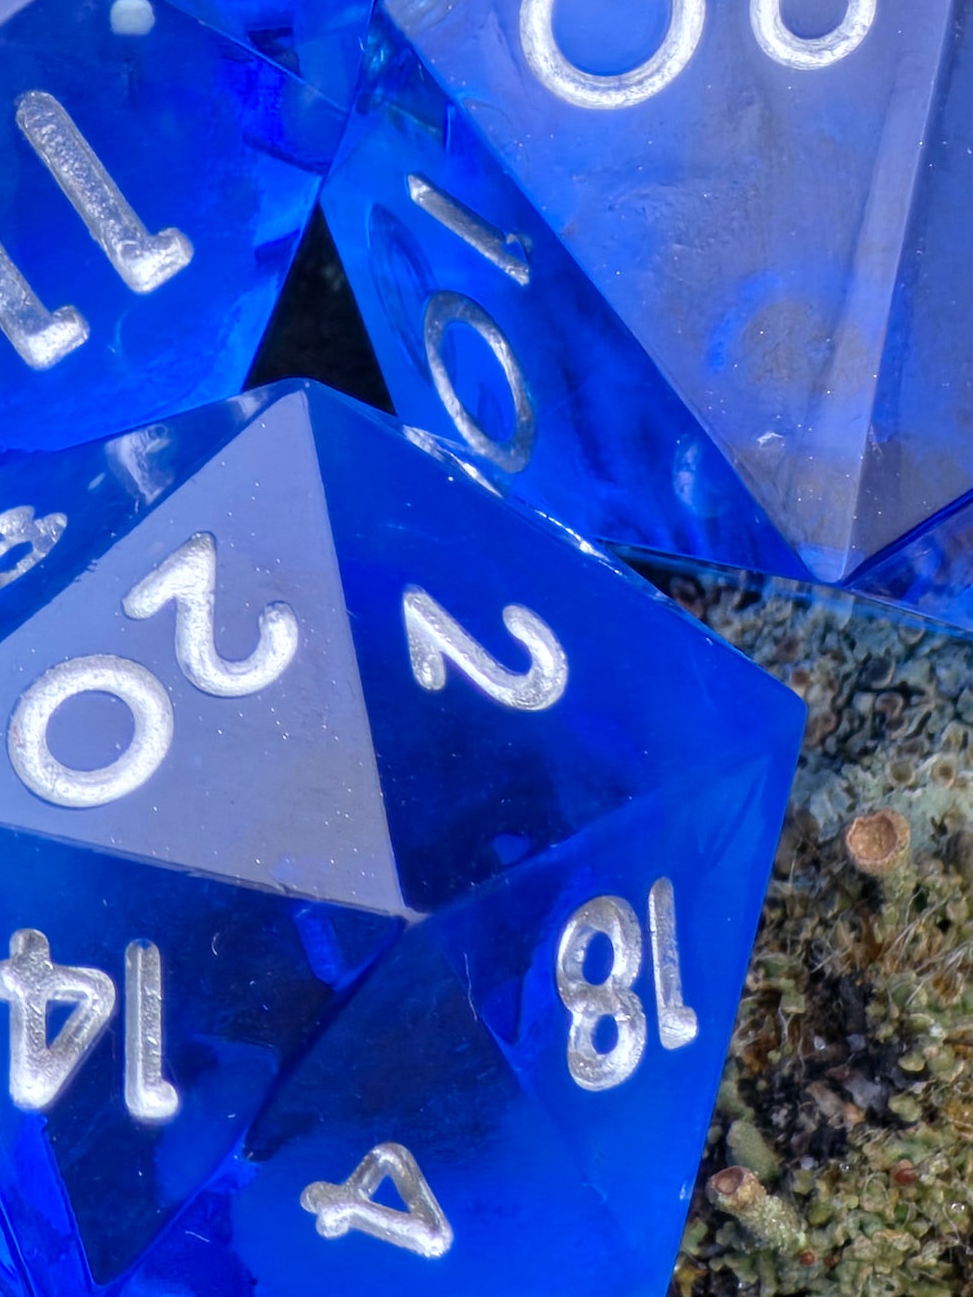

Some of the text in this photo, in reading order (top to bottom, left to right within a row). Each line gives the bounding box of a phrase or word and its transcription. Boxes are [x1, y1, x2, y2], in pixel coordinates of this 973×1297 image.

[6, 531, 299, 809] 20
[402, 584, 569, 712] 2
[556, 877, 699, 1093] 18
[299, 1141, 453, 1259] 4
